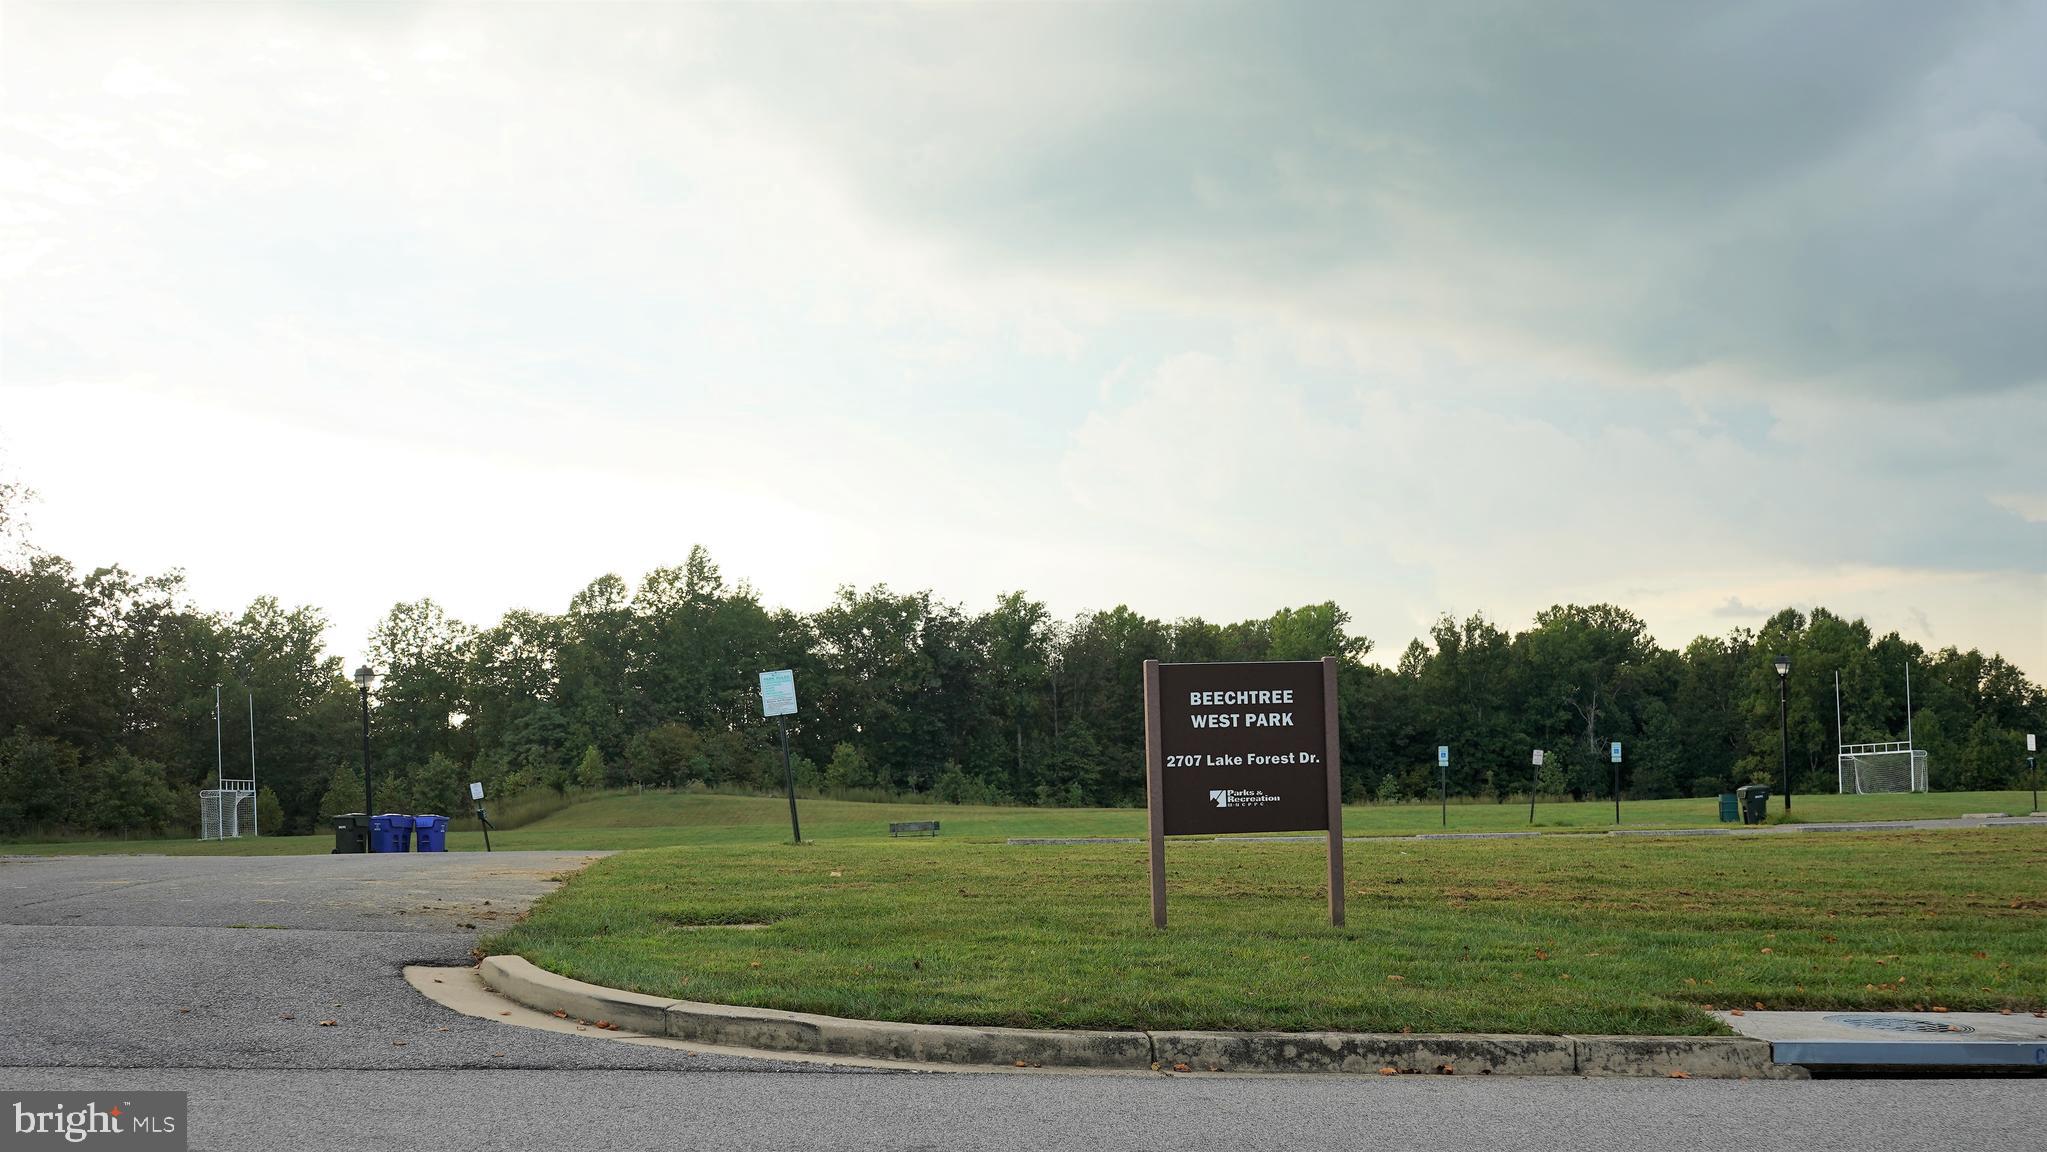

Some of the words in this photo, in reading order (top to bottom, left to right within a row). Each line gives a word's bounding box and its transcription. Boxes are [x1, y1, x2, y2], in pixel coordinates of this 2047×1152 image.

[1190, 689, 1294, 706] BEECHTREE
[1190, 713, 1240, 729] WEST
[1245, 712, 1294, 727] PARK
[1166, 754, 1202, 768] 2707
[1206, 754, 1243, 767] Lake
[1247, 752, 1295, 765] Forest
[1299, 751, 1320, 764] Dr.
[1227, 795, 1281, 803] Recreation
